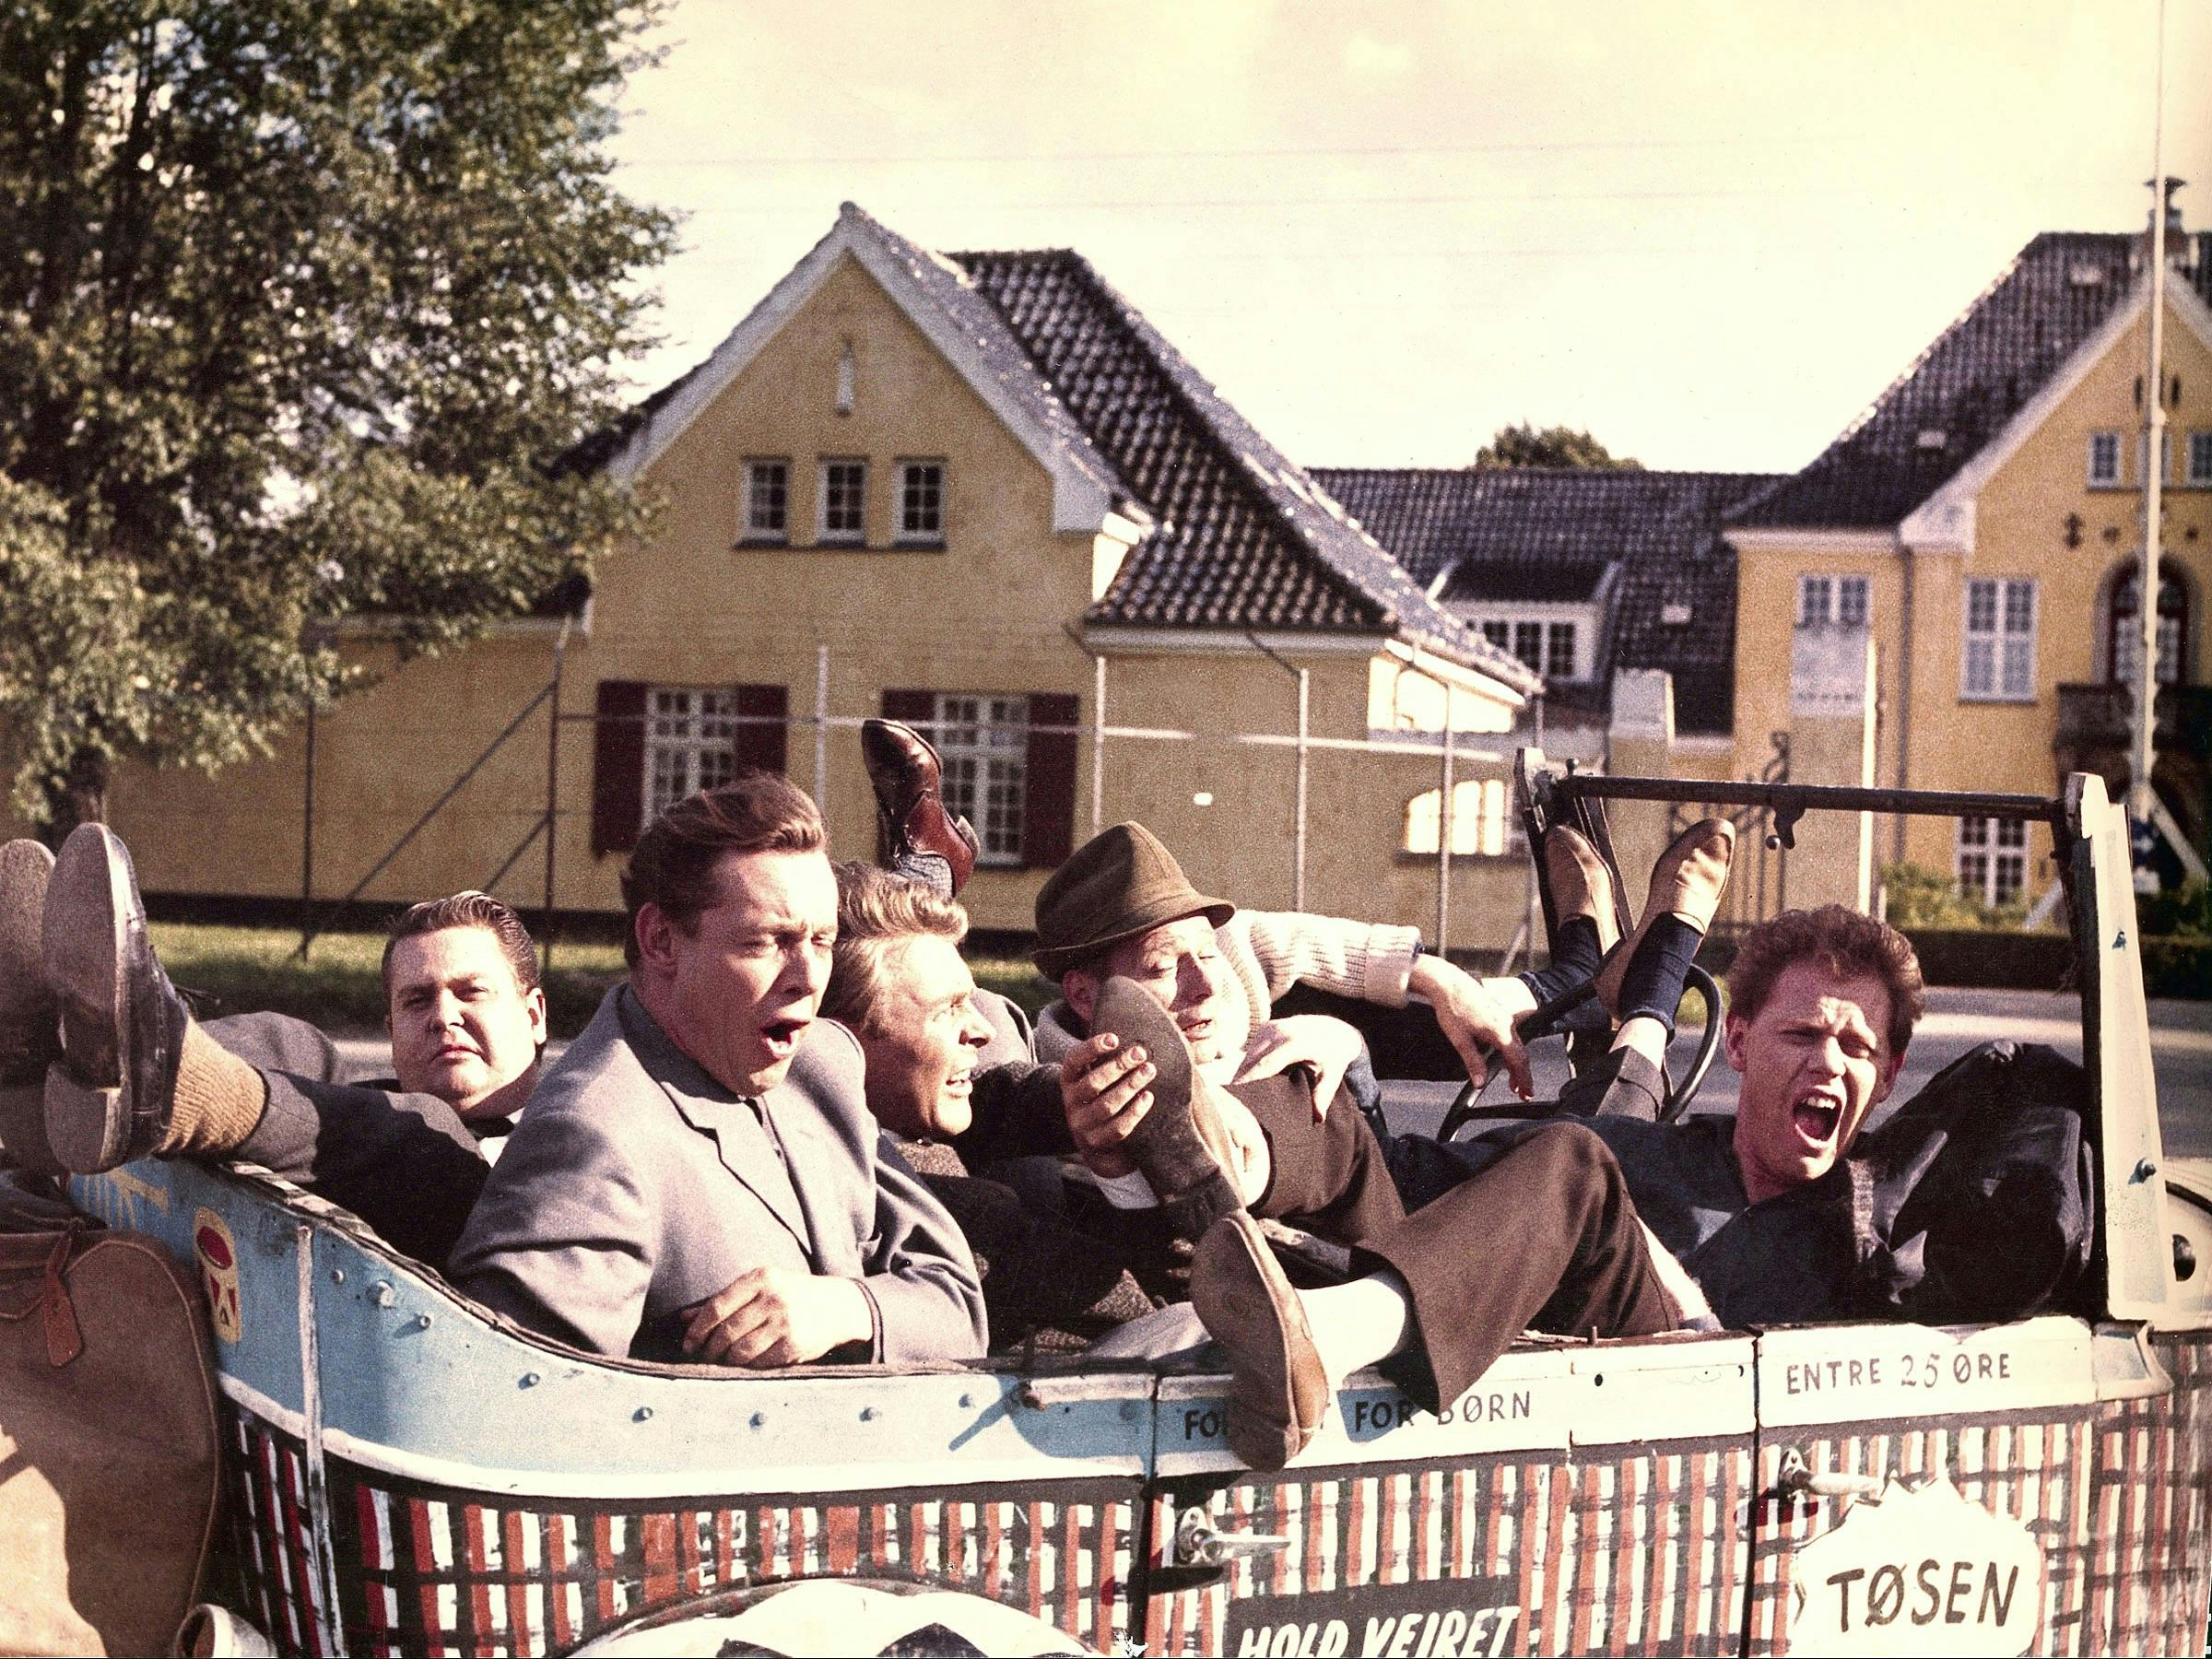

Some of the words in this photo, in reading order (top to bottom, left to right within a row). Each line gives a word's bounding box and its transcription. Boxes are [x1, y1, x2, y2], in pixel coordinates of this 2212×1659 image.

[1787, 1358, 1881, 1394] ENTRE
[1900, 1353, 1940, 1388] 25
[1953, 1353, 2010, 1383] ØRE
[1355, 1400, 1414, 1432] FOR
[1827, 1559, 2019, 1633] TØSEN
[1238, 1619, 1349, 1657] HOLD
